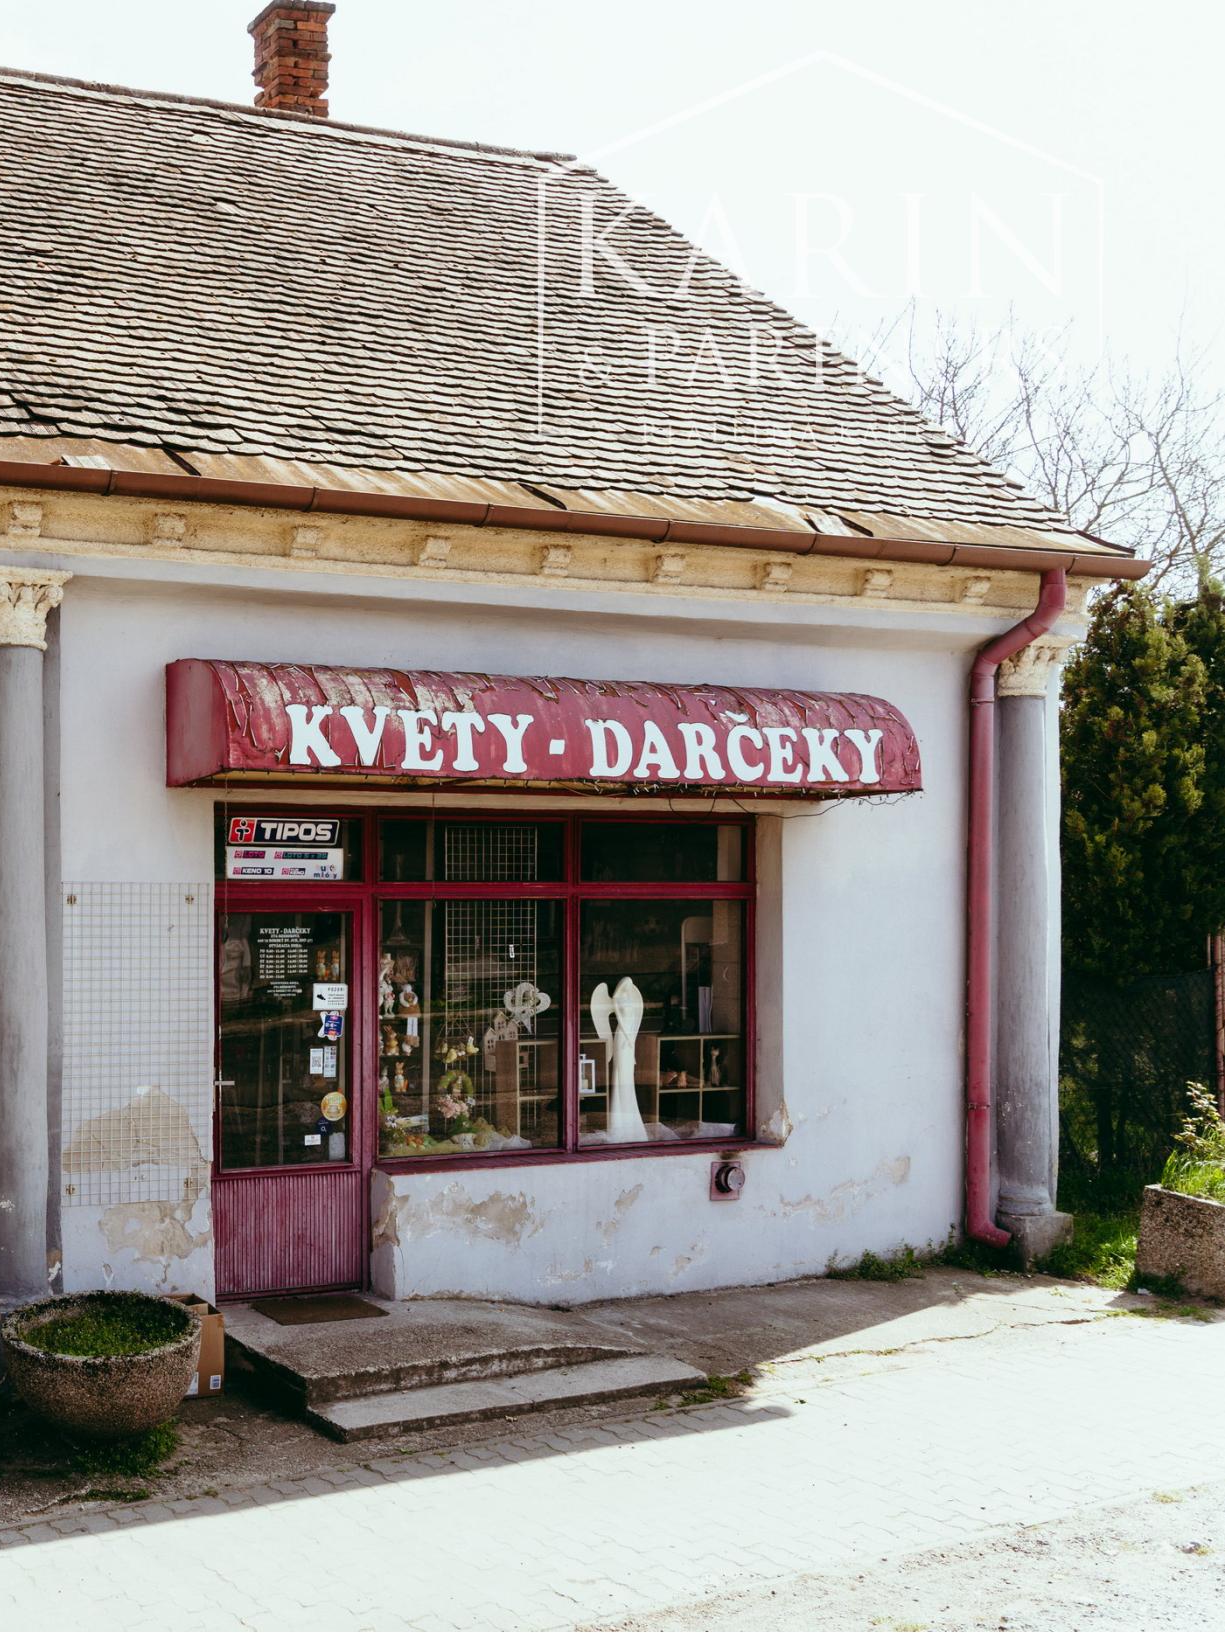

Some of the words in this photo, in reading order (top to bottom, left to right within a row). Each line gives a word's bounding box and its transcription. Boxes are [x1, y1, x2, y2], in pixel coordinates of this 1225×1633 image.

[285, 704, 534, 773] KVETY
[585, 709, 883, 784] DARČEKY
[260, 822, 333, 841] TIPOS
